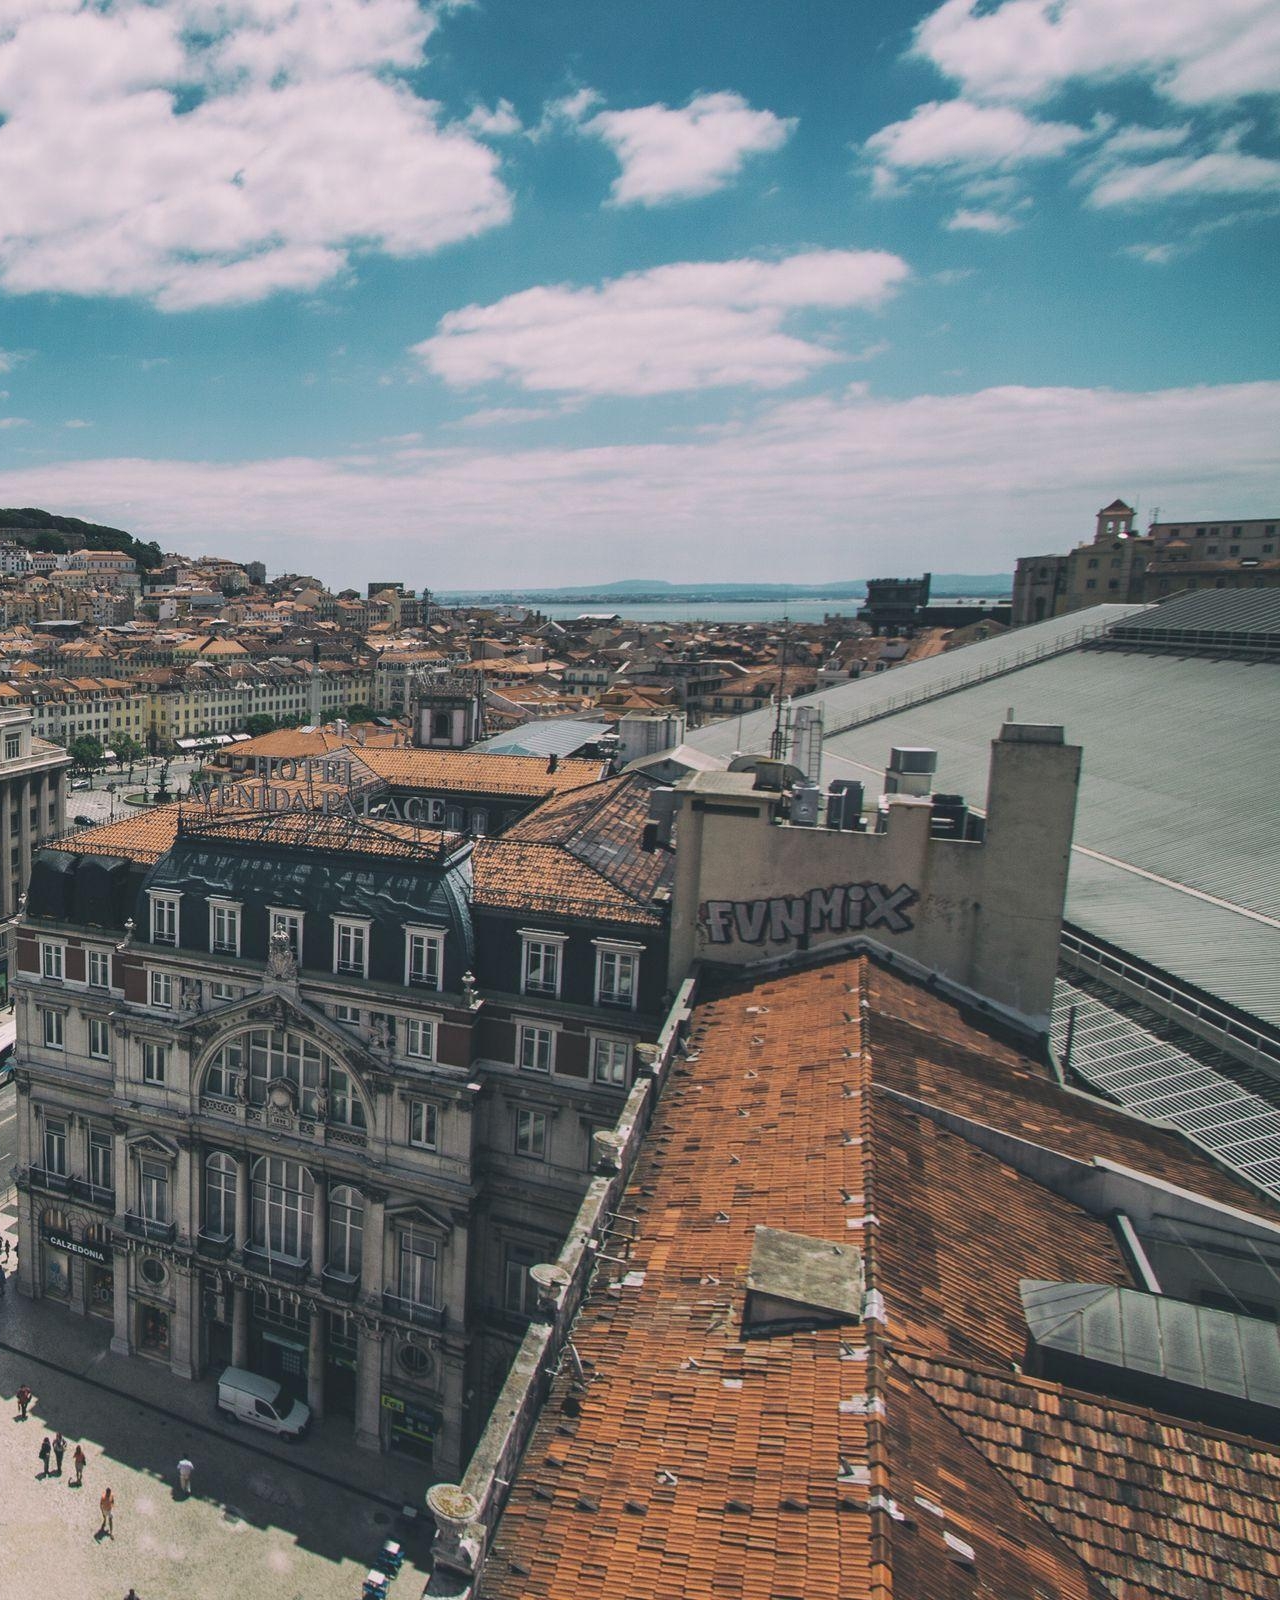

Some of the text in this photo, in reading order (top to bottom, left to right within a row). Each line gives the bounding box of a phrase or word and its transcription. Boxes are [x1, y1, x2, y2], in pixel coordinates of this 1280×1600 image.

[254, 757, 362, 786] HOTEL
[185, 781, 446, 825] AVENIDA PALACE
[50, 1236, 105, 1261] CALZEDONIA
[213, 1268, 318, 1312] AVENIDA
